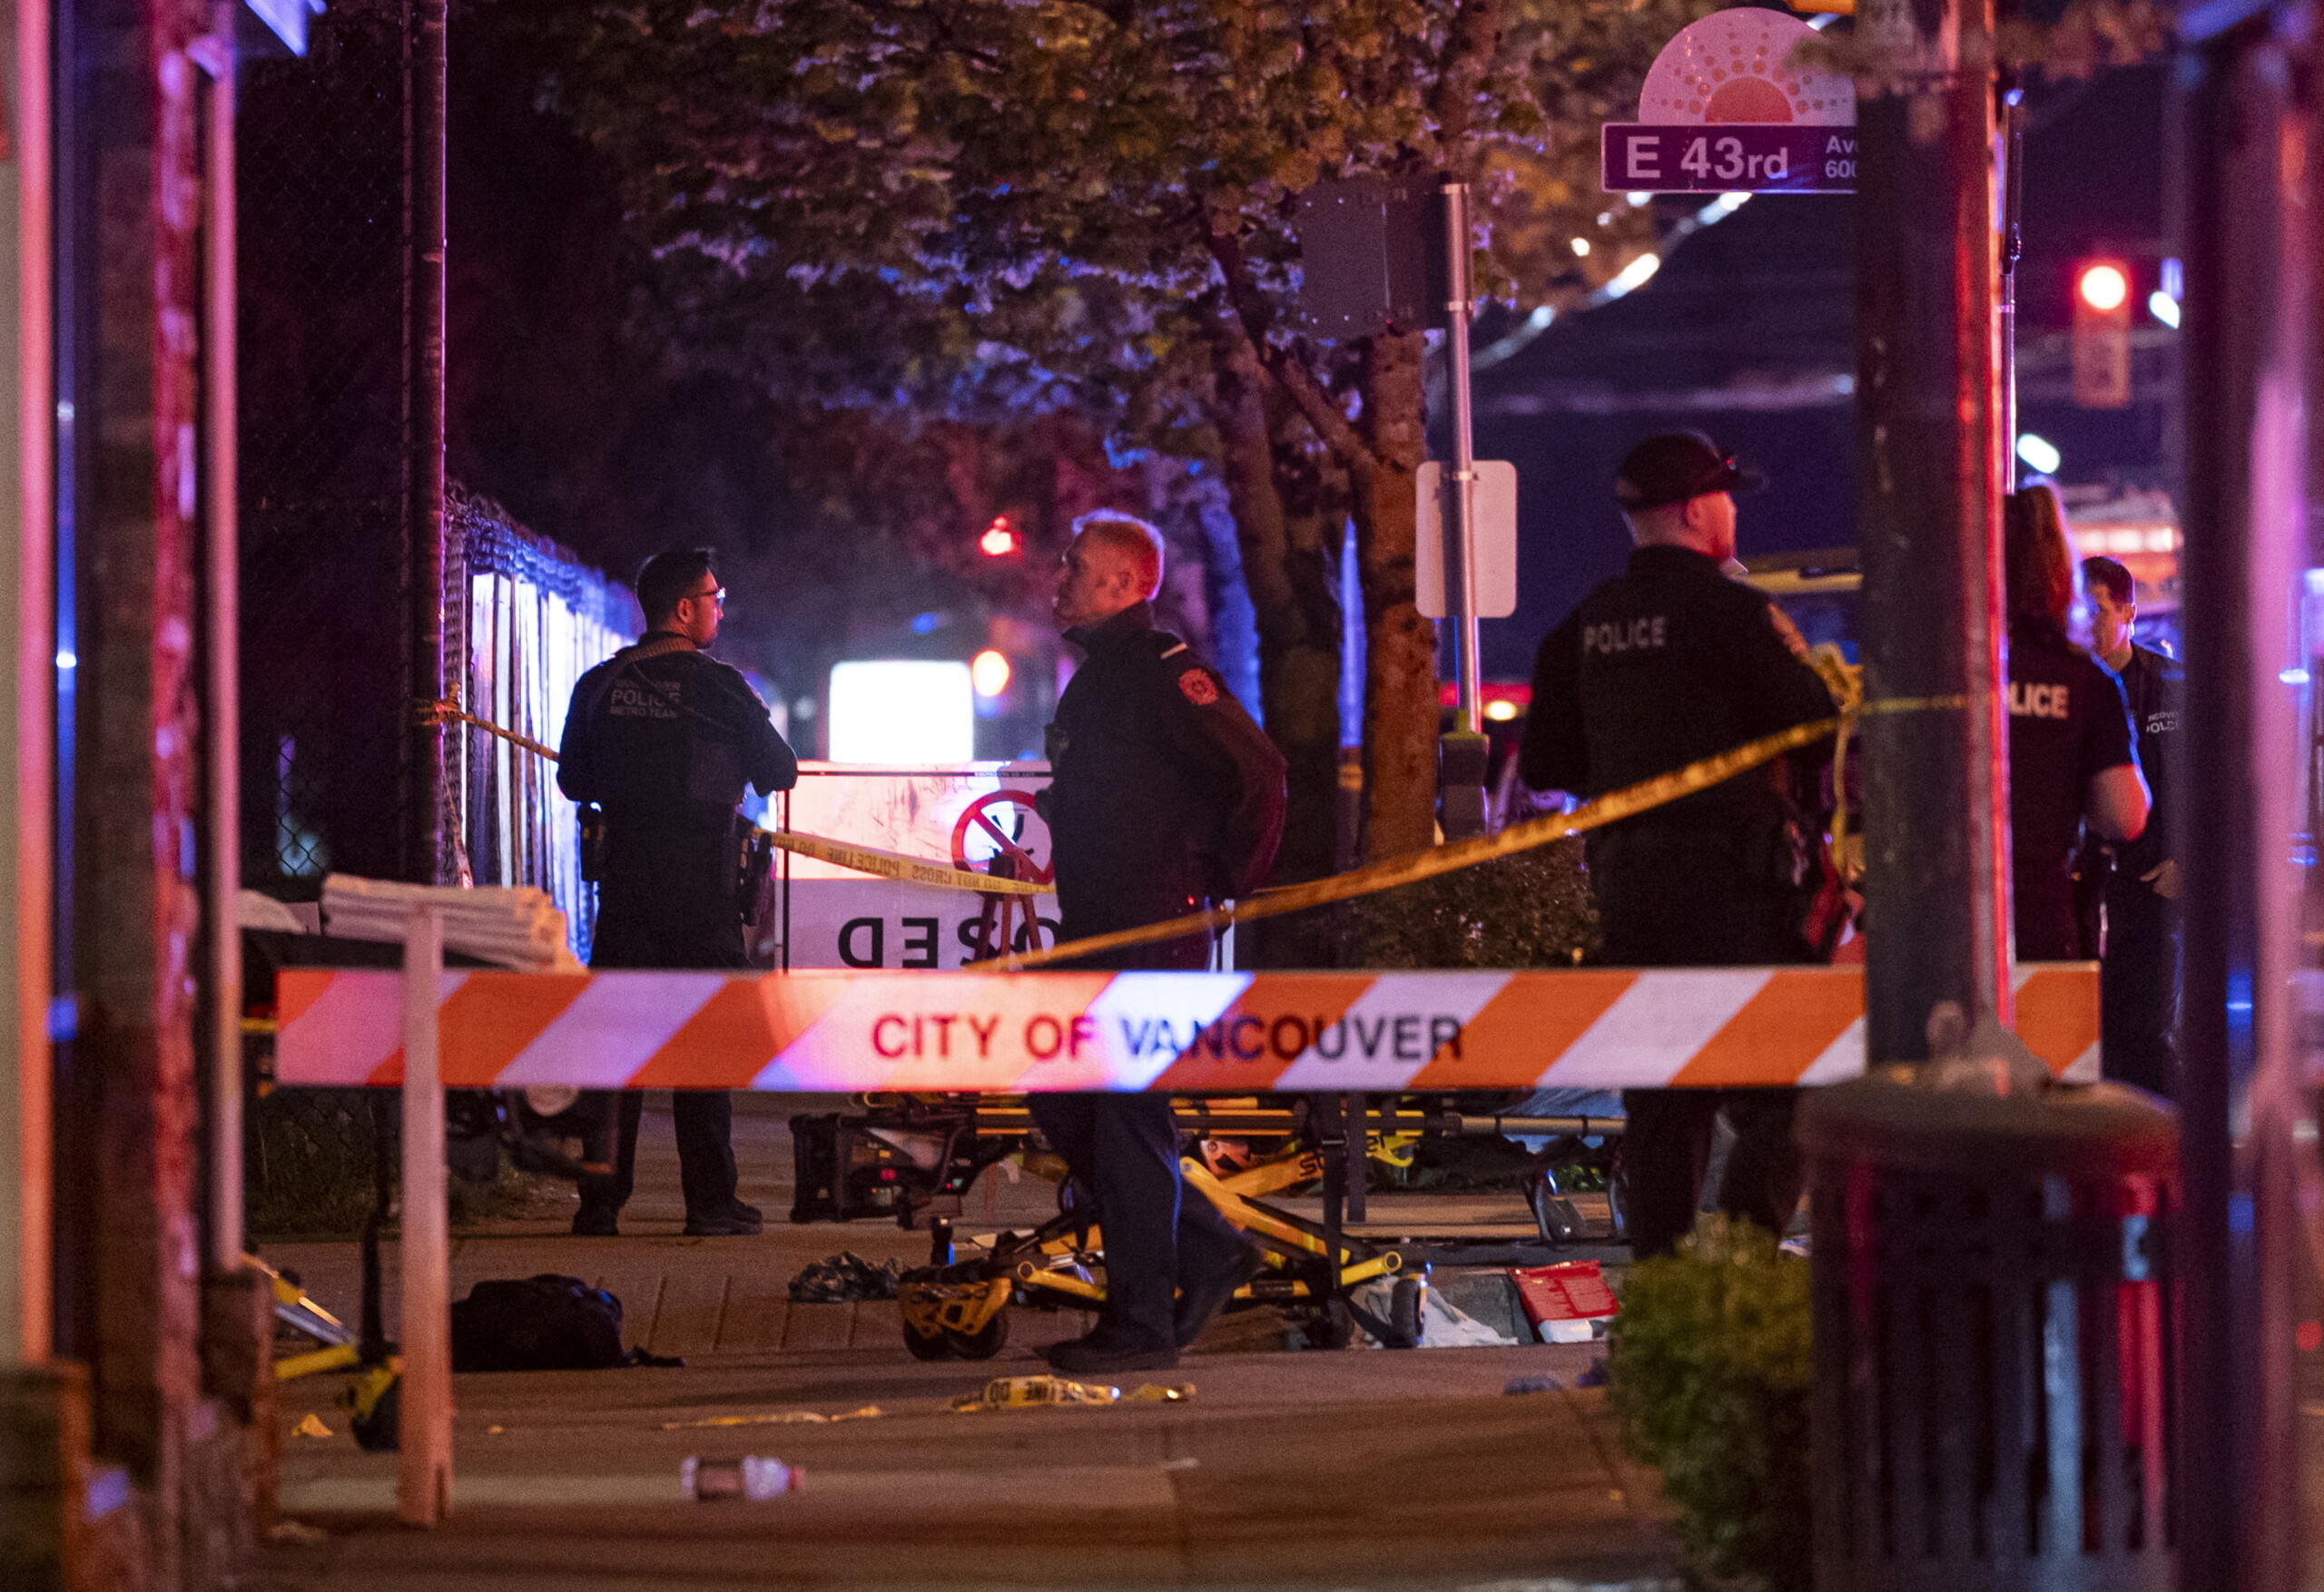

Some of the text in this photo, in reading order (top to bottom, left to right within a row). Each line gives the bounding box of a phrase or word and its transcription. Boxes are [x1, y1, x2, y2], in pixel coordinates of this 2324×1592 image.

[1627, 136, 1788, 179] E 43rd
[1826, 136, 1857, 153] Av
[1583, 616, 1666, 654] POLICE
[2008, 683, 2069, 719] LICE
[872, 1014, 1463, 1060] CITY OF VANCOUVER
